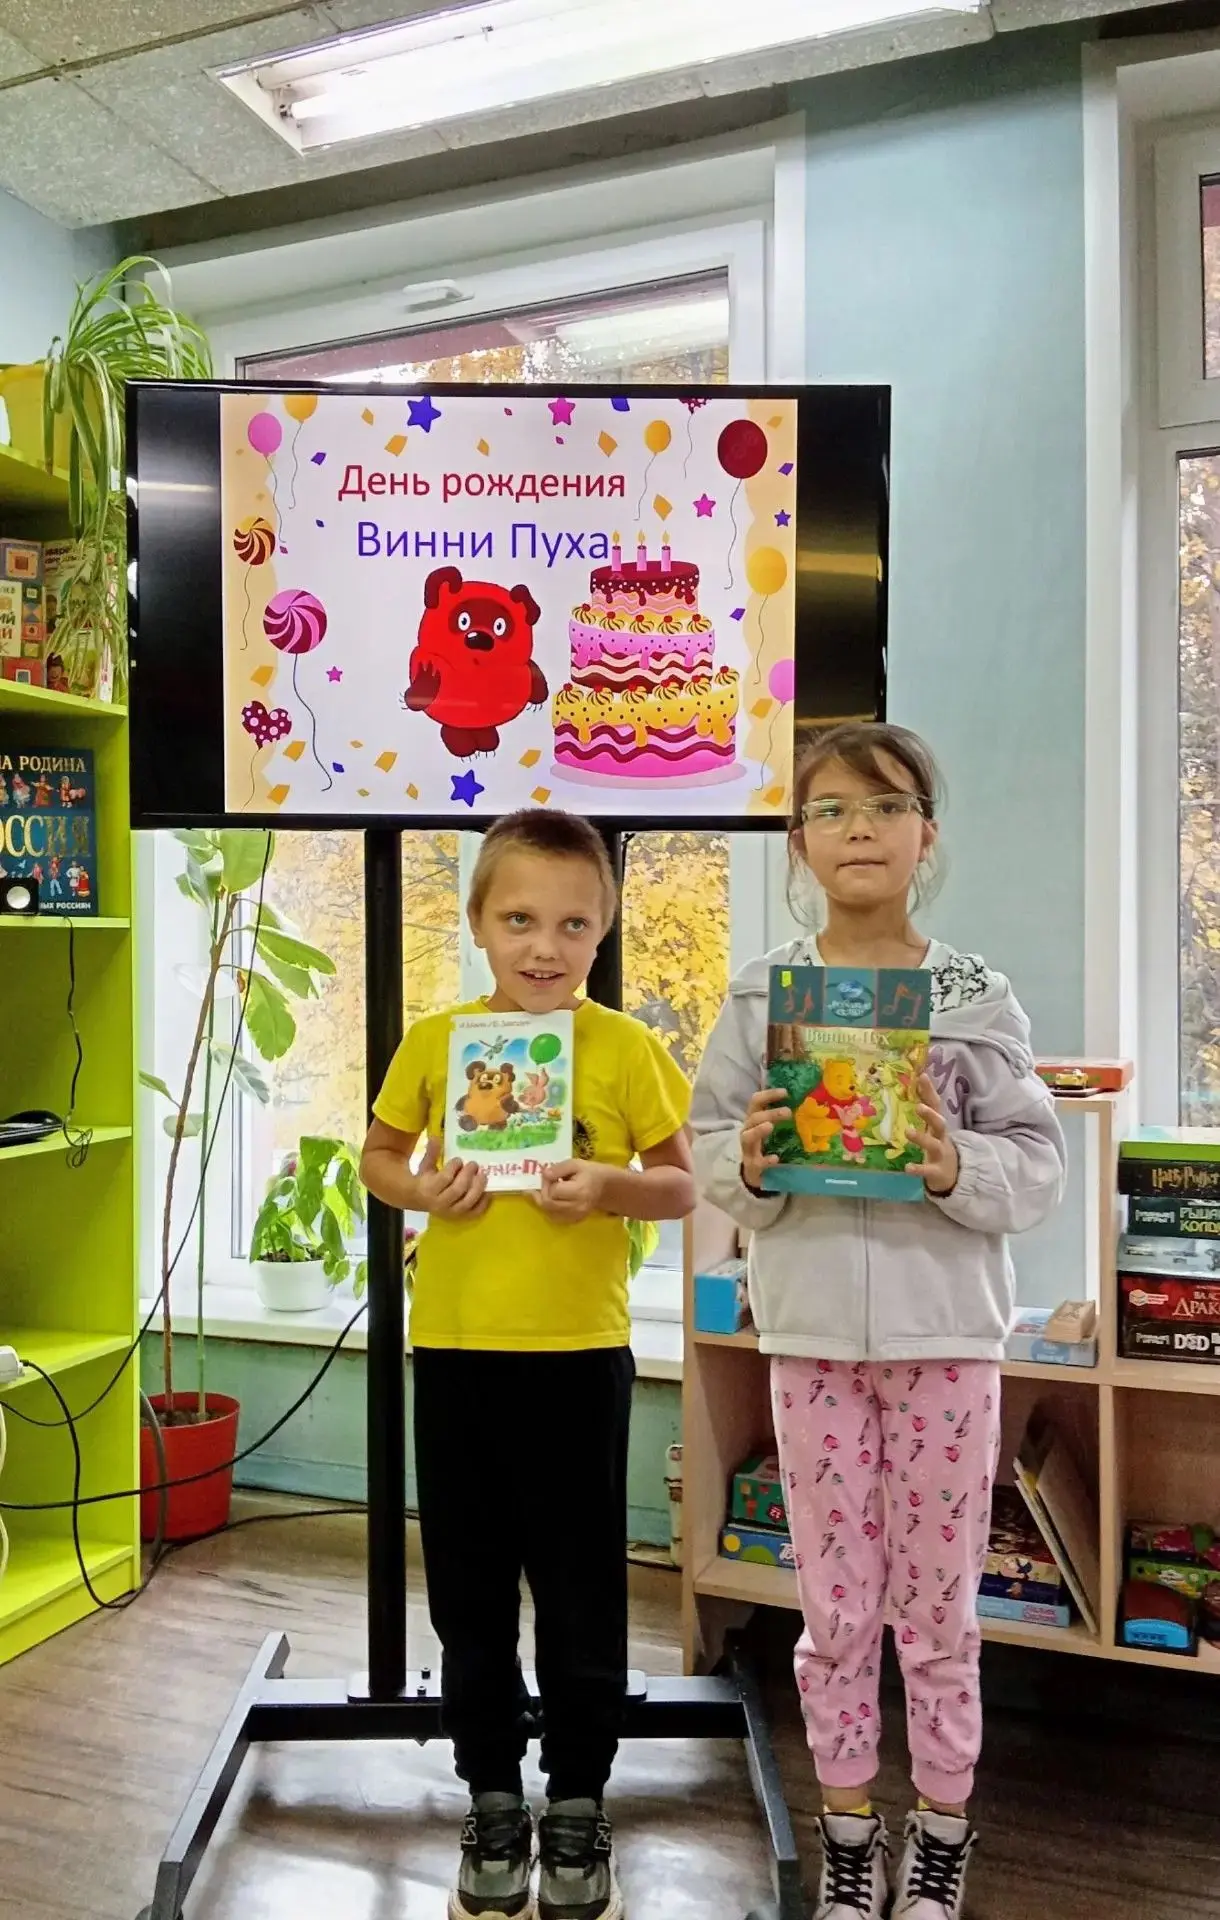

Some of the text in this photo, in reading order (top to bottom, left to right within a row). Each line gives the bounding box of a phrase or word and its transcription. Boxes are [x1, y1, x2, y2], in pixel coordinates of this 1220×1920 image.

[337, 465, 625, 503] День рождения
[357, 521, 609, 568] Винни Пуха
[19, 755, 87, 774] РОДИНА
[56, 902, 92, 911] РОССИЯН
[1171, 1298, 1220, 1317] ДРАК
